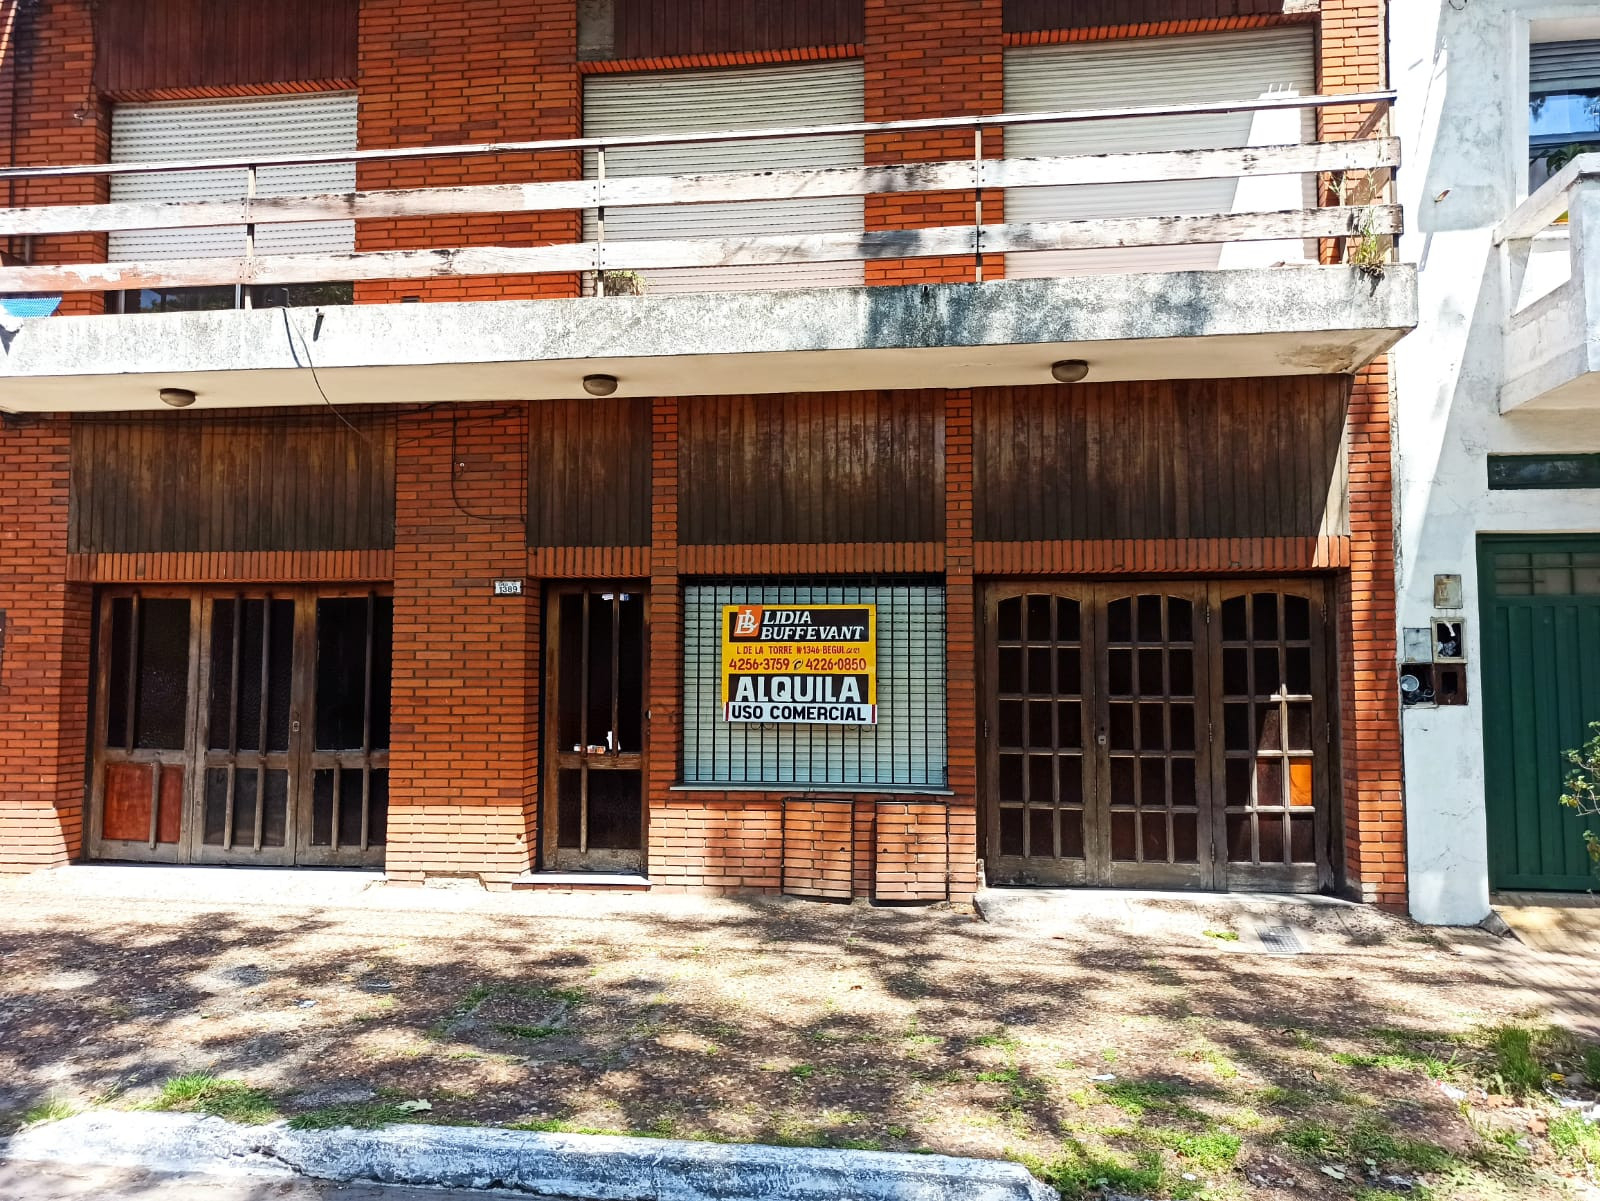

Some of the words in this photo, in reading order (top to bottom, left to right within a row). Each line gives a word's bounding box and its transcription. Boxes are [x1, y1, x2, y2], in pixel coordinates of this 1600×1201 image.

[763, 611, 812, 625] LIDIA
[760, 626, 864, 640] BUFFEVANT
[744, 646, 752, 654] DE
[755, 646, 764, 655] LA
[768, 646, 793, 654] TORRE
[728, 658, 790, 670] 4256-3759
[805, 658, 867, 670] 4226-0850
[735, 676, 861, 702] ALQUILA
[731, 705, 763, 719] USO
[770, 706, 867, 721] COMERCIAL
